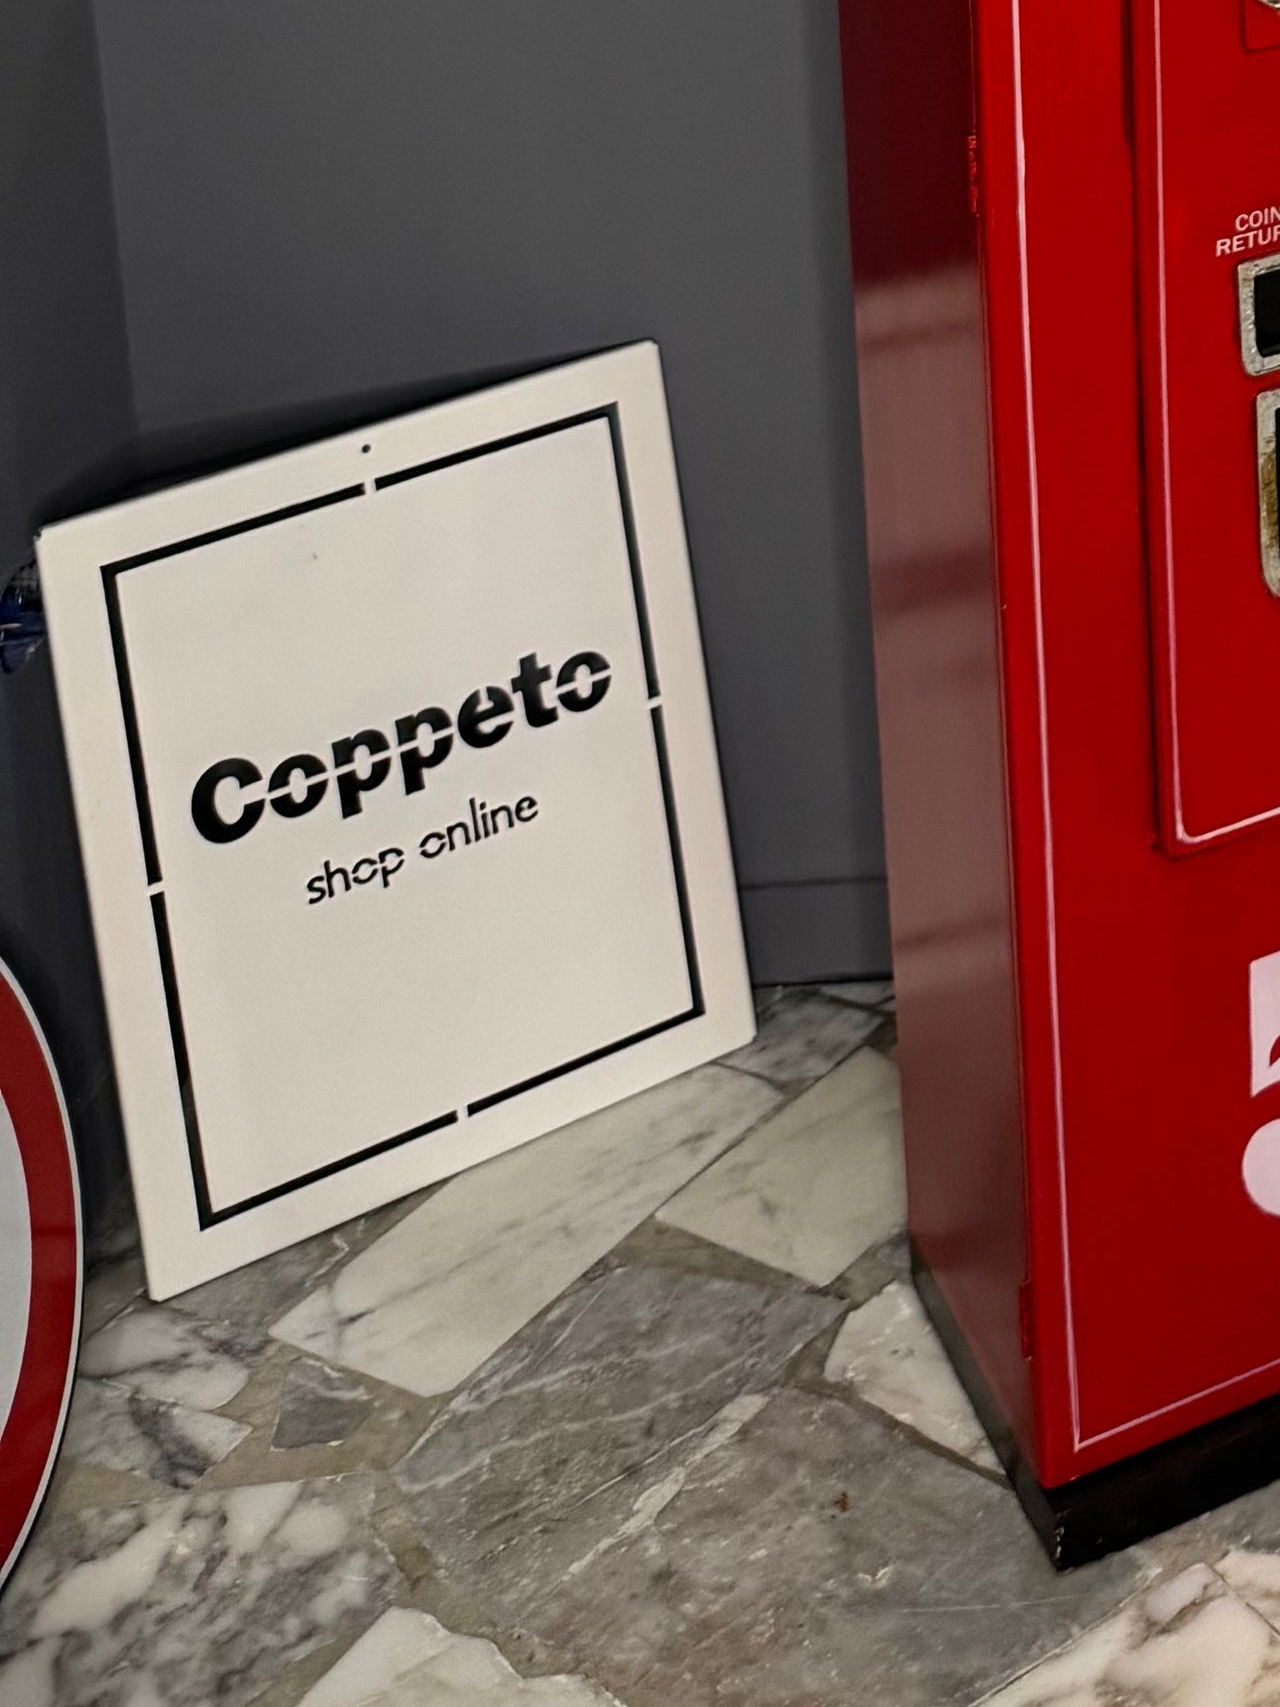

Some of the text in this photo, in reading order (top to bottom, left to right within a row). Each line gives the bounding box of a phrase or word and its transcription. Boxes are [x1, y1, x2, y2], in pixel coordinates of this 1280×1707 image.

[191, 650, 612, 844] Coppeto
[306, 795, 540, 906] shop online
